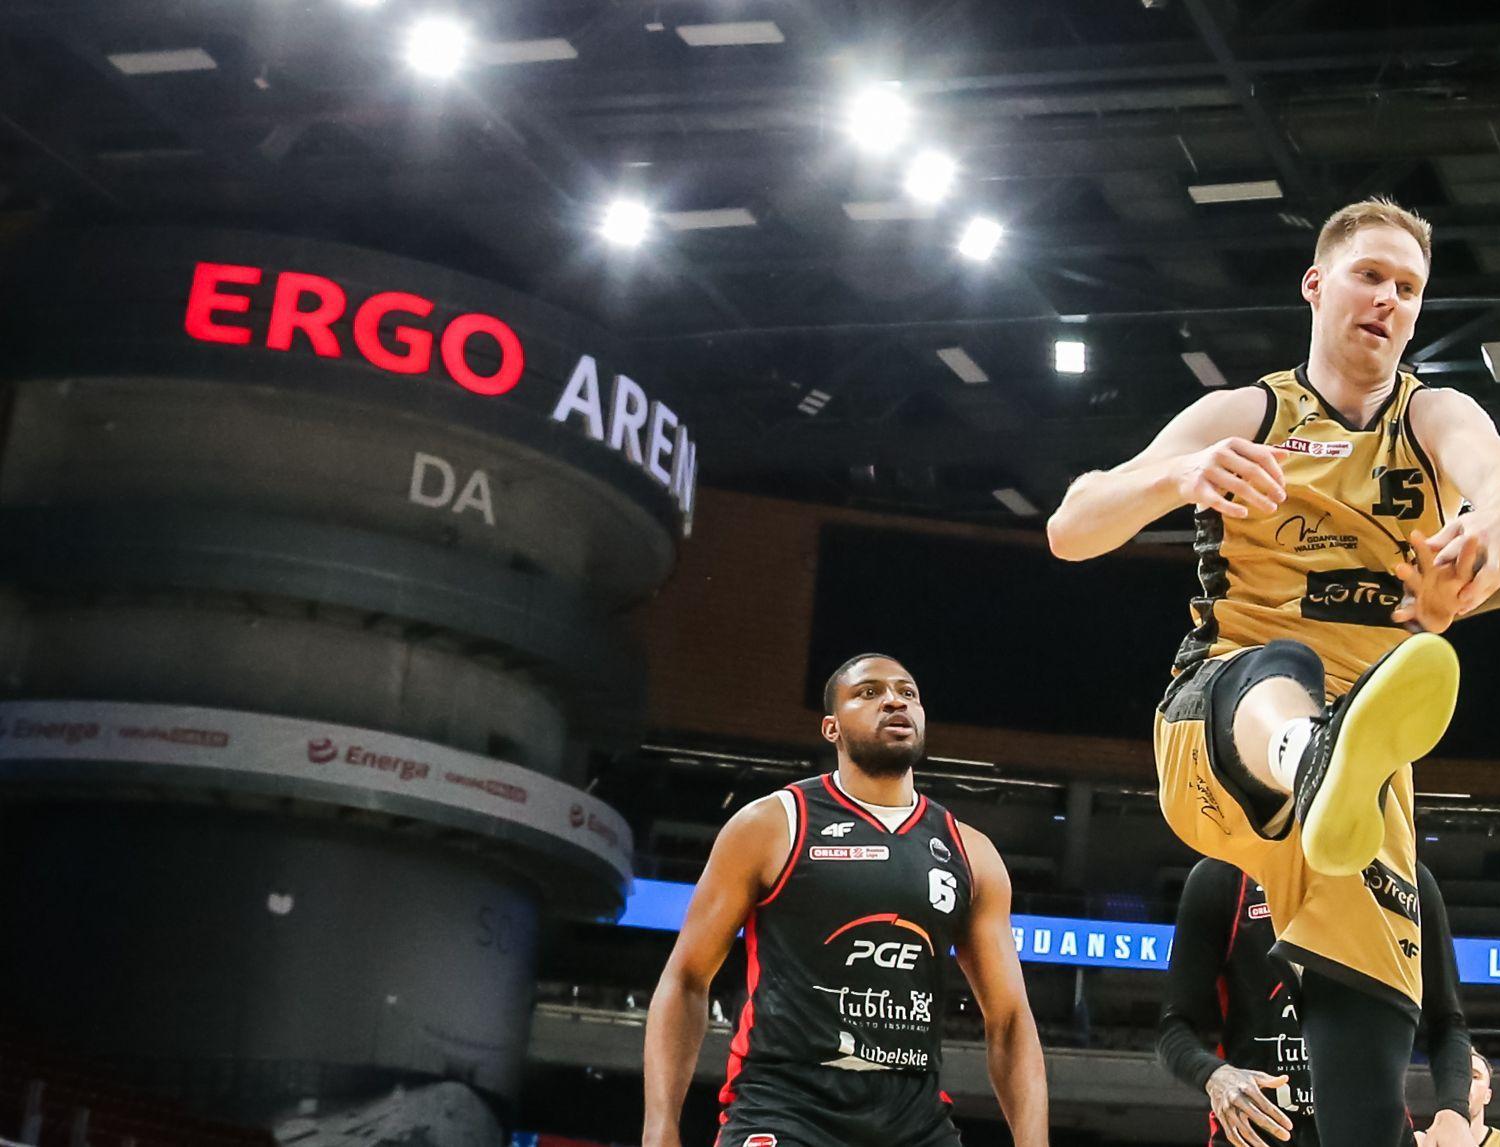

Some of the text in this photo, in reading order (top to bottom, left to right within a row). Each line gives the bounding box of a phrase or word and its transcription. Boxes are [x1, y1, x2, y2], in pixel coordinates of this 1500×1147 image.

[184, 261, 697, 537] ERGO AREN
[409, 452, 494, 525] DA
[1372, 466, 1425, 520] 15
[346, 746, 430, 781] Energa
[821, 822, 855, 837] 4F
[813, 848, 849, 858] ORLEN
[928, 867, 957, 914] 6
[845, 940, 922, 970] PGE
[861, 1044, 929, 1067] lubelskie
